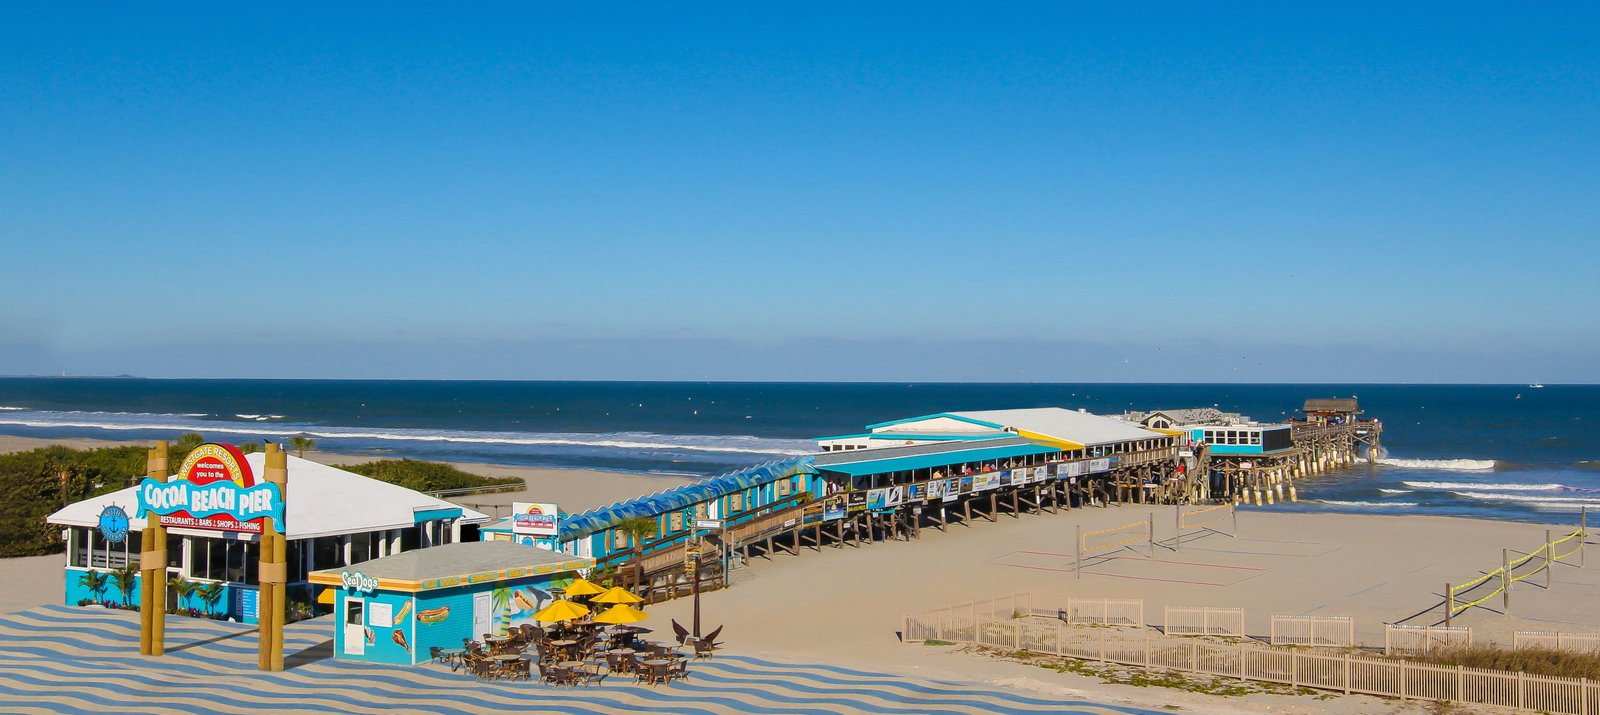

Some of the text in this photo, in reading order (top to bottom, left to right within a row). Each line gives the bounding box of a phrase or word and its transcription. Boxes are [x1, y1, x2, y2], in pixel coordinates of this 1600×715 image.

[181, 446, 241, 480] WESTGATE RESORTS
[196, 462, 225, 470] welcomes
[145, 483, 273, 516] COCOA BEACH PIER
[160, 515, 194, 525] RESTAURANTS
[217, 520, 234, 528] SHOPS
[239, 522, 260, 530] FISHING
